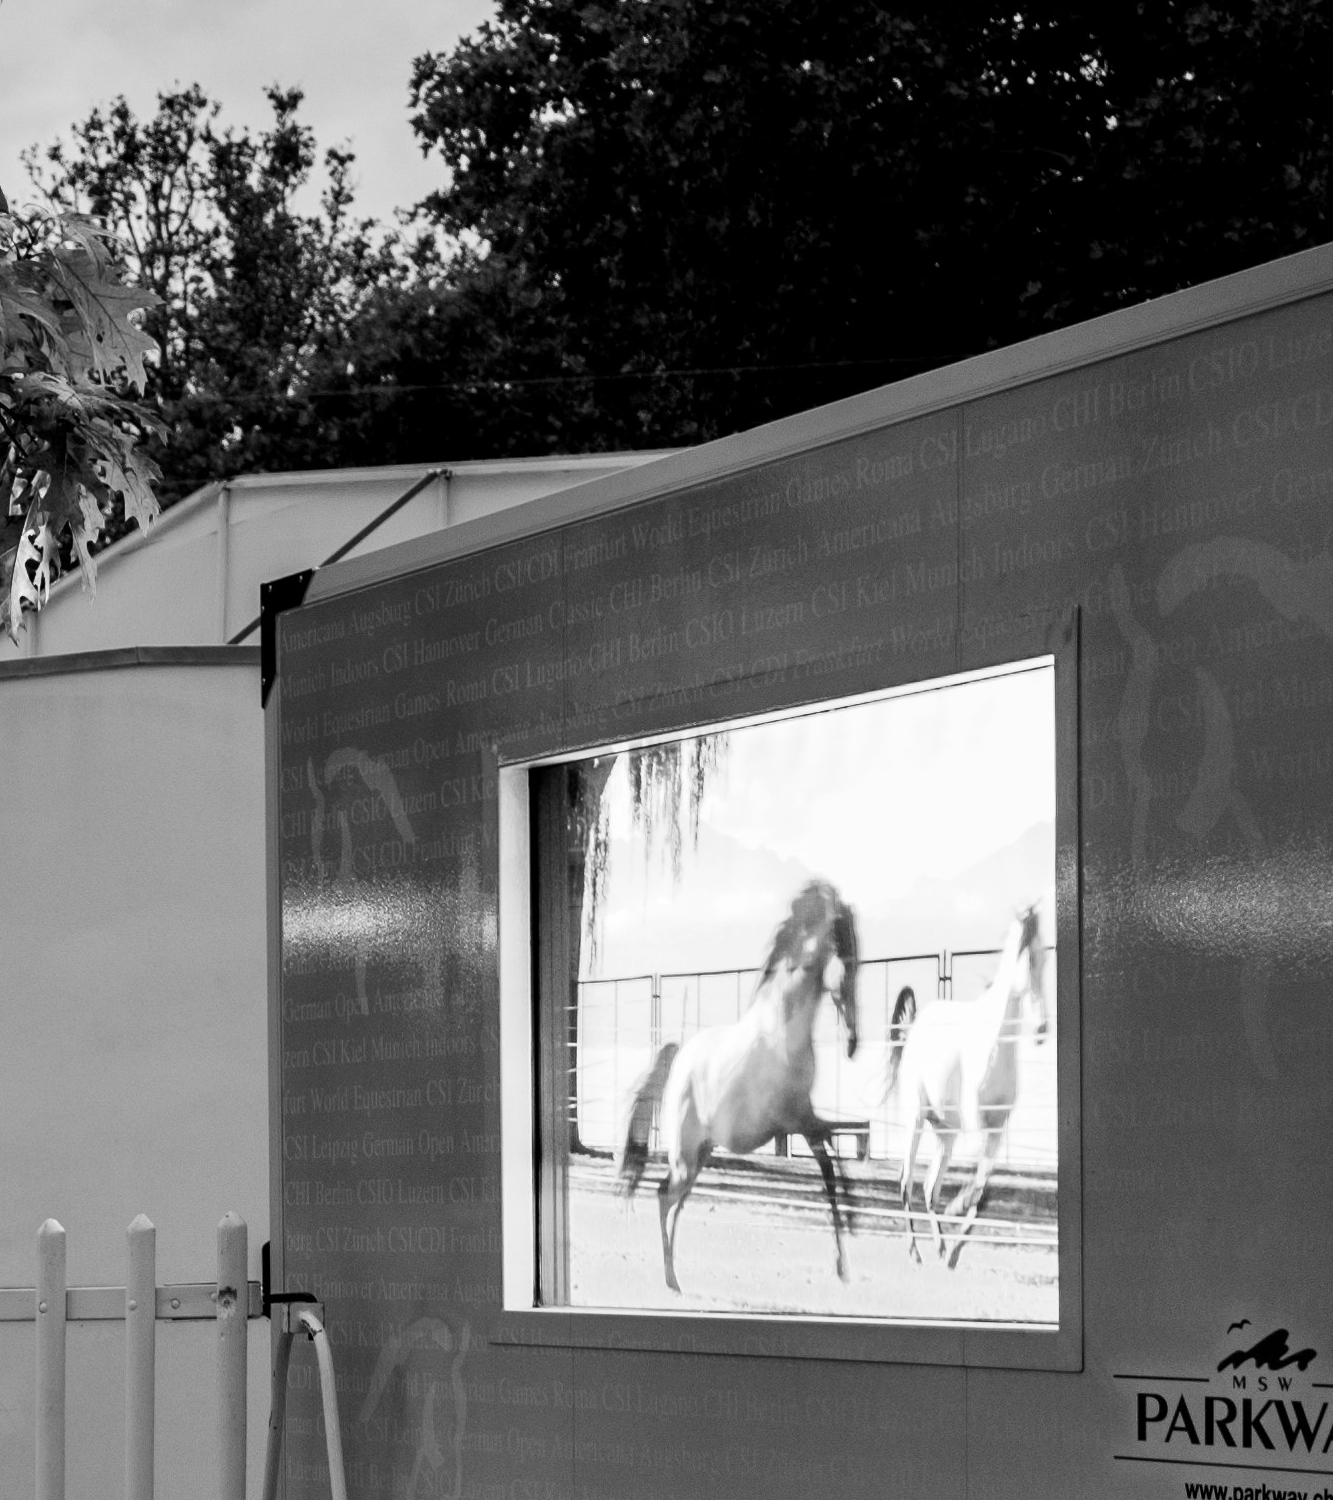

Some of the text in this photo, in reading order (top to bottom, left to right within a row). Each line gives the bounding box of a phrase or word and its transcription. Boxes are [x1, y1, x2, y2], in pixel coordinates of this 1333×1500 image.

[349, 600, 411, 638] Augsburg
[414, 585, 440, 615] CSI
[633, 514, 683, 551] World
[855, 452, 913, 490] Roma
[920, 429, 957, 470] CSI
[1052, 385, 1100, 432] CHI
[1109, 370, 1181, 418] Berlin
[331, 658, 380, 687] Indoors
[383, 642, 408, 674] CSI
[413, 631, 481, 666] Hannover
[485, 614, 543, 646] German
[609, 578, 643, 614] CHI
[651, 566, 701, 602] Berlin
[708, 552, 741, 588] CSI
[818, 509, 921, 558] Americana
[1041, 455, 1132, 499] German
[323, 704, 390, 742] Equestrian
[394, 691, 441, 720] Games
[446, 679, 487, 708] Roma
[491, 663, 520, 696] CSI
[588, 637, 622, 672] CHI
[629, 624, 679, 663] Berlin
[685, 609, 733, 649] CSIO
[741, 600, 804, 637] Luzern
[811, 580, 847, 618] CSI
[856, 566, 897, 608] Kiel
[994, 533, 1074, 576] Indoors
[1086, 510, 1129, 551] CSI
[1140, 485, 1262, 540] Hannover
[334, 991, 369, 1027] Ope
[312, 1039, 337, 1067] CSI
[340, 1036, 367, 1065] Kiel
[353, 1082, 422, 1118] Equestrian
[426, 1078, 453, 1107] CSI
[362, 1131, 414, 1158] German
[419, 1129, 454, 1163] Open
[357, 1178, 393, 1206] CSIO
[398, 1177, 444, 1205] Luzern
